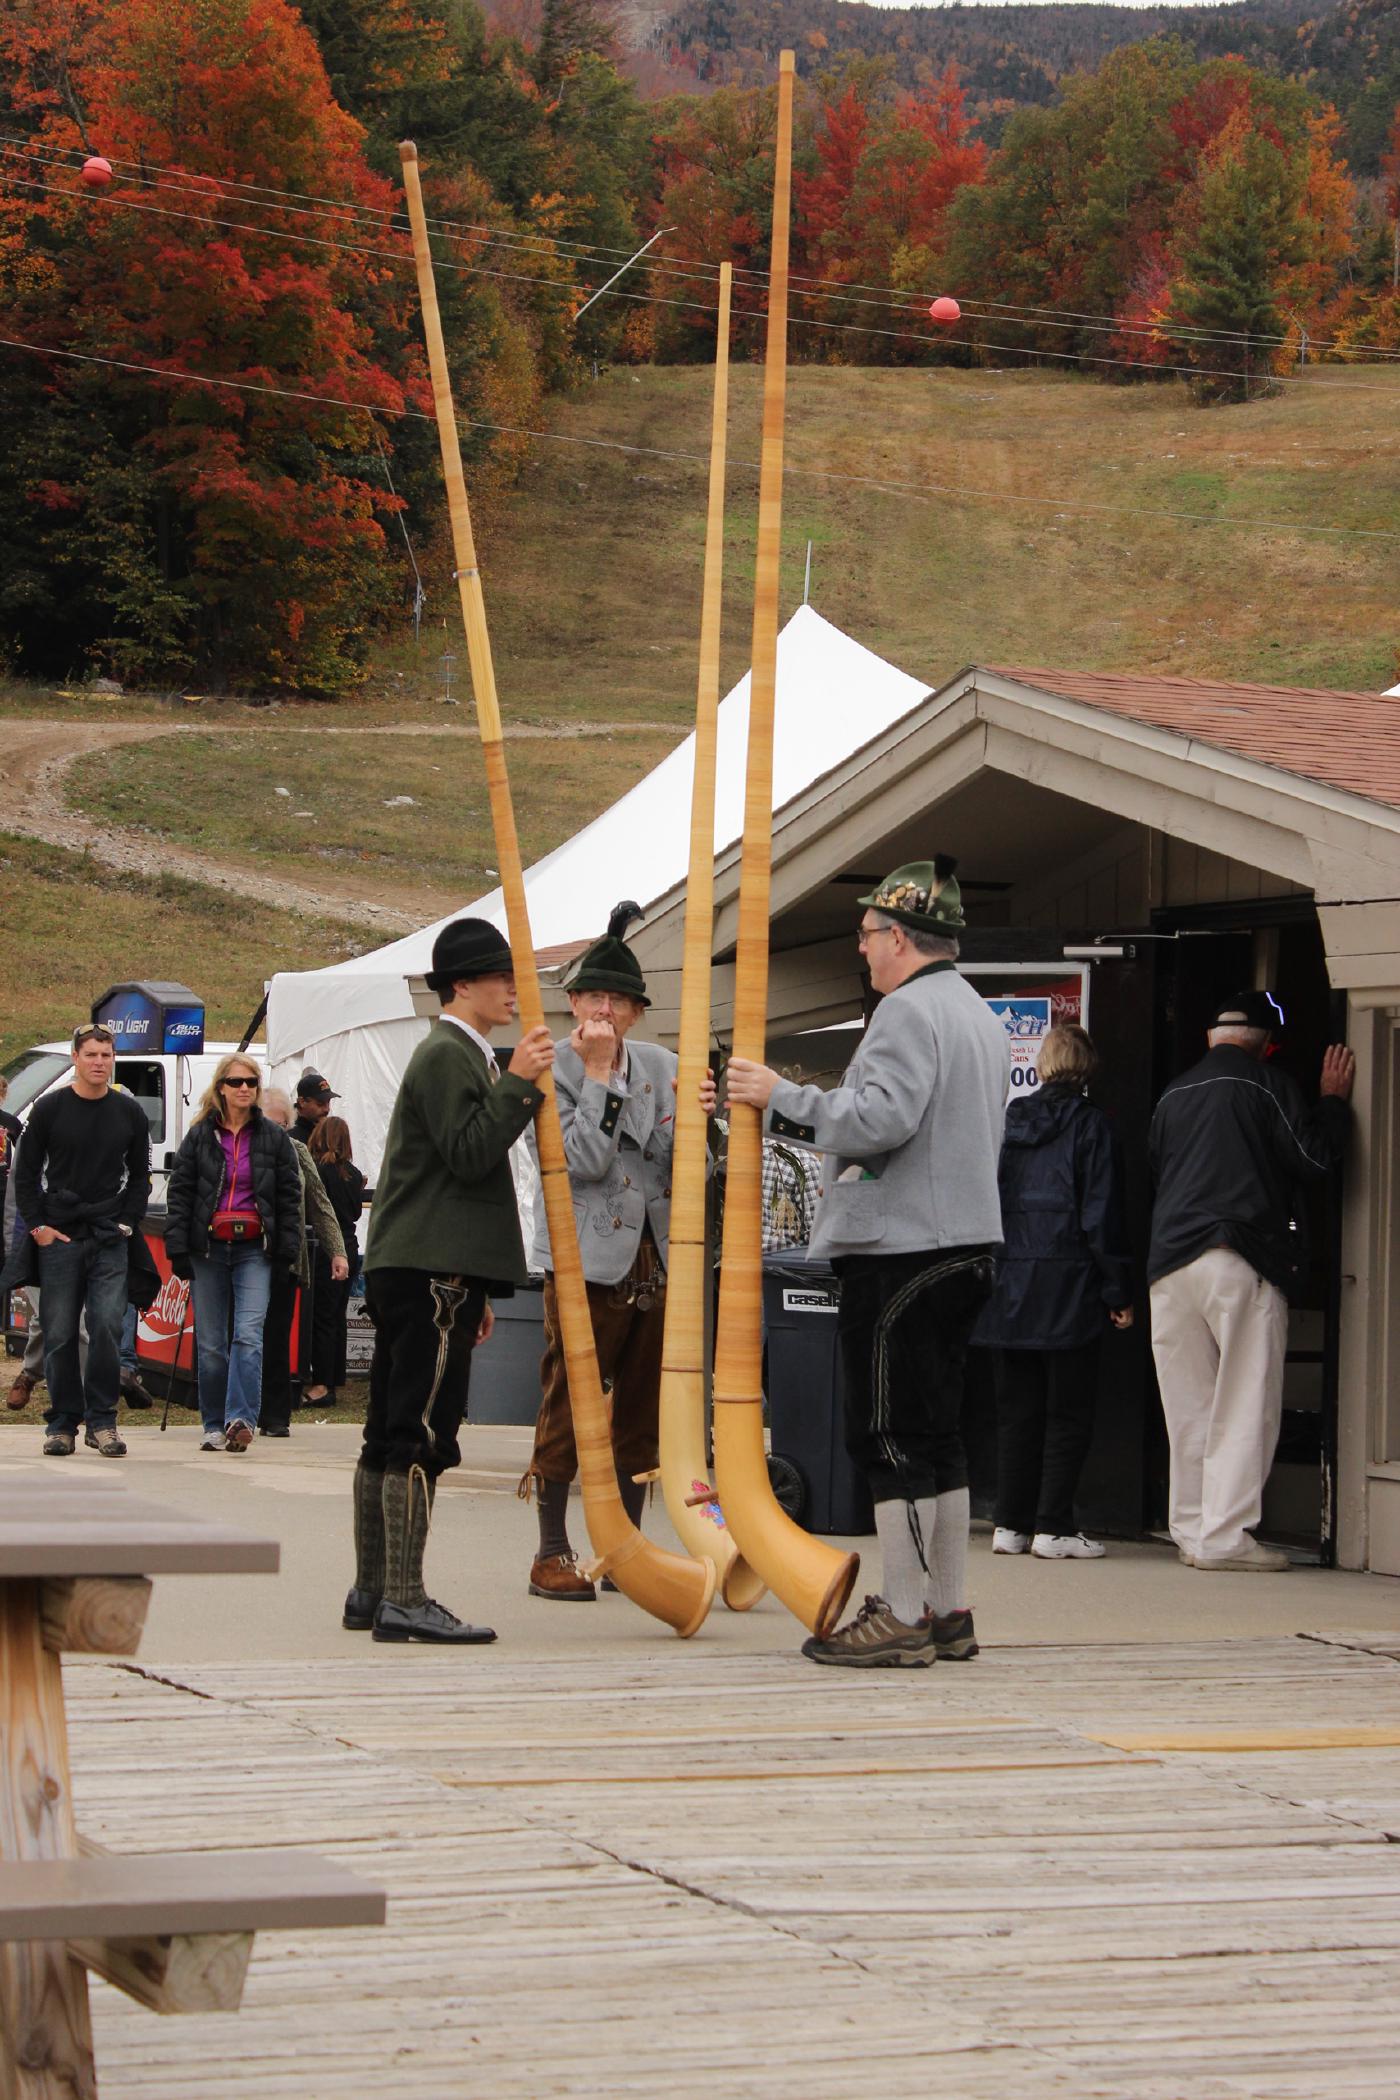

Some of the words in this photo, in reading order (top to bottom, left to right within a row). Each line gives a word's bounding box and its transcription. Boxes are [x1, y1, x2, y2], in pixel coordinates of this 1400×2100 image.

[107, 1020, 124, 1034] BUD
[126, 1020, 150, 1034] LIGHT
[1005, 1020, 1048, 1035] SCH
[1010, 1066, 1039, 1087] 00
